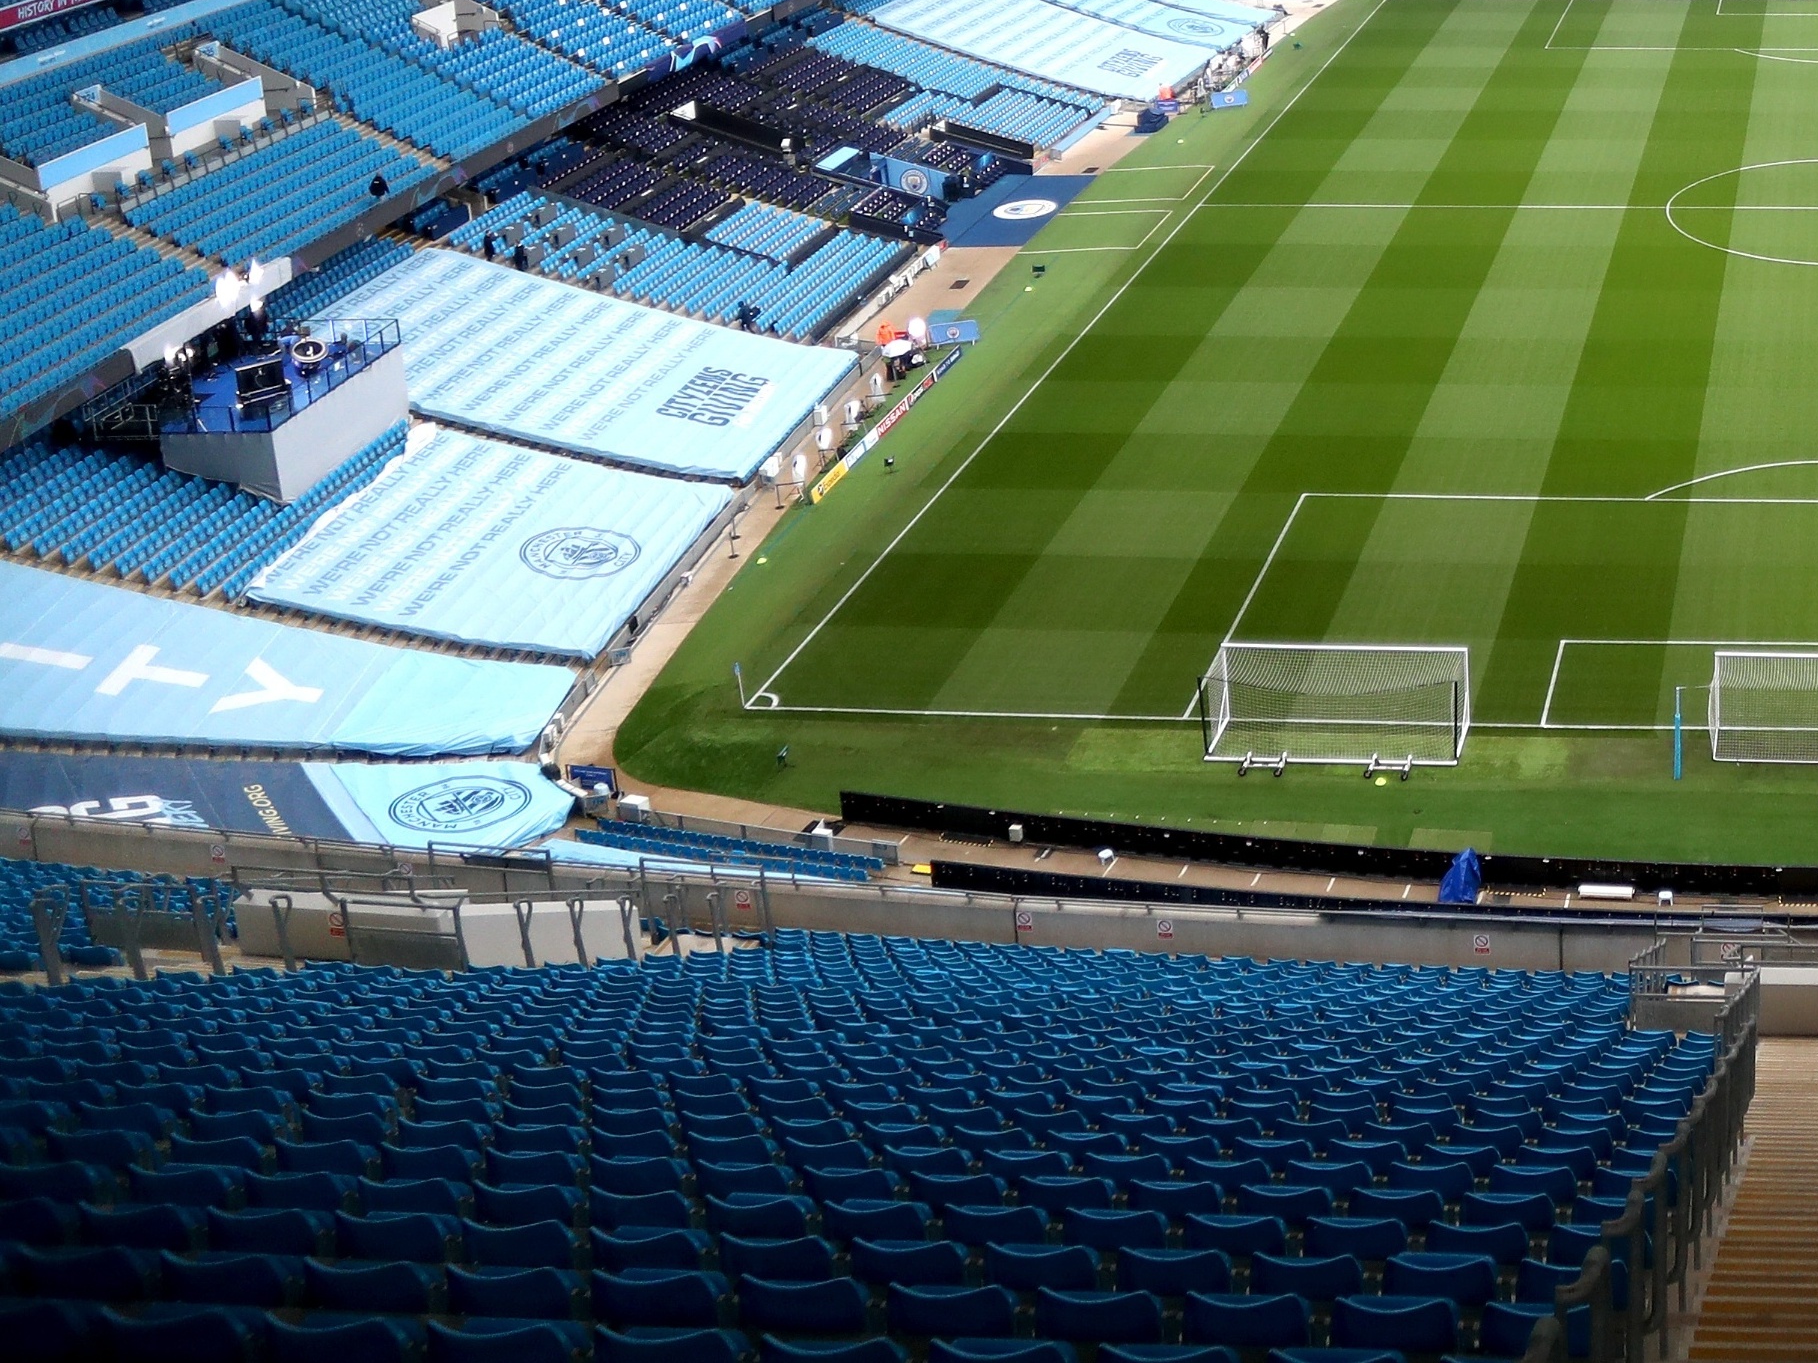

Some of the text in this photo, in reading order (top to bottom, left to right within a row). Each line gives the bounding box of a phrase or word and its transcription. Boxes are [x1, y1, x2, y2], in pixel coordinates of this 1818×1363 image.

[578, 327, 717, 443] WE'RE NOT REALLY HERE
[655, 366, 733, 420] CITYZENS
[687, 373, 771, 428] GIVING
[877, 401, 907, 436] NISSAN
[398, 462, 573, 617] WE'RE NOT REALLY HERE
[528, 530, 584, 571] MANCHESTER
[613, 550, 635, 567] CITY
[396, 791, 458, 830] MANCHESTER
[502, 787, 522, 801] CITY
